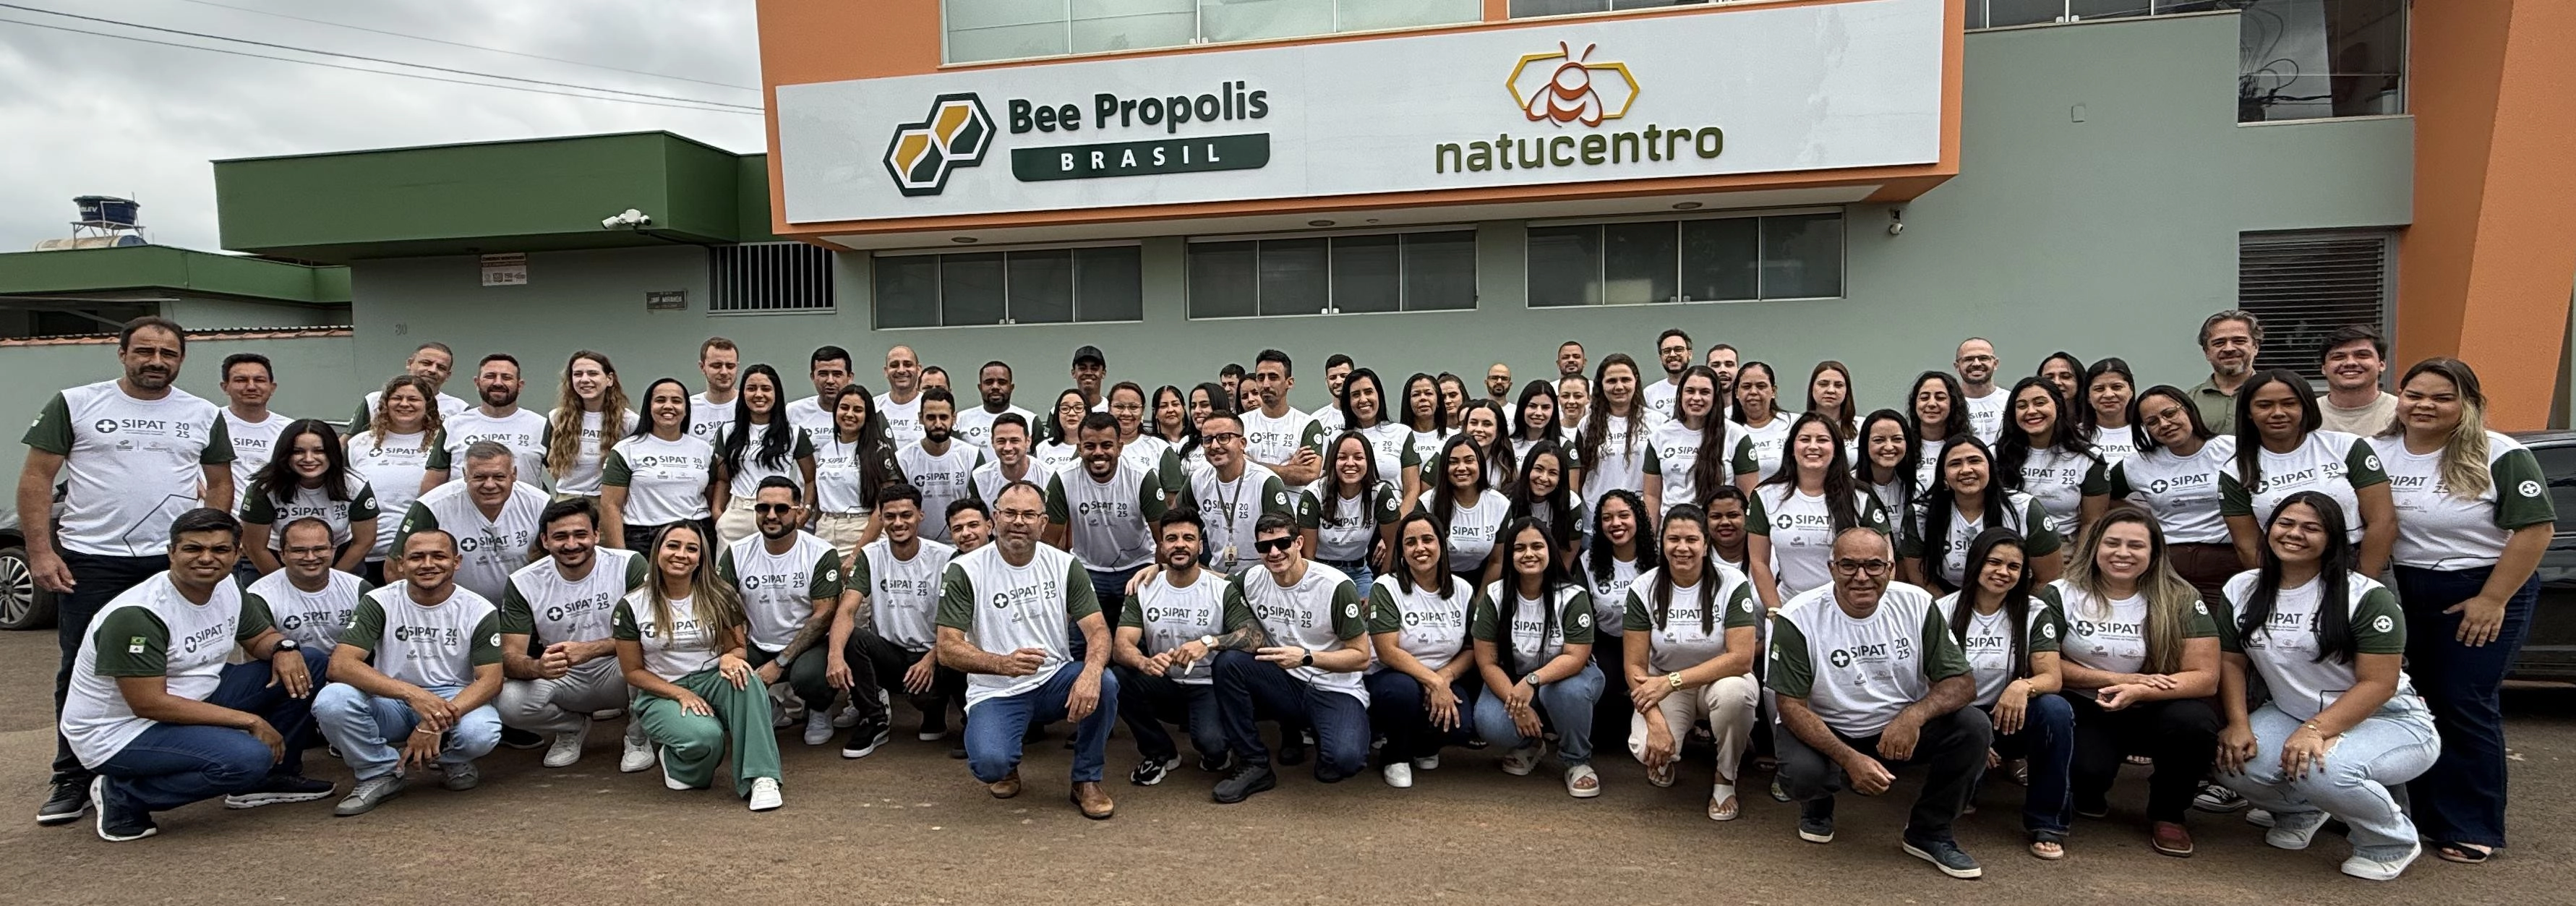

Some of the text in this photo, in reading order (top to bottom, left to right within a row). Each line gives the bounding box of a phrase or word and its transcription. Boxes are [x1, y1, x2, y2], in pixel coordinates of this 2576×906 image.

[1008, 80, 1269, 134] Bee Propolis
[1436, 124, 1723, 174] natucentro
[1060, 144, 1220, 171] BRASIL
[121, 419, 166, 430] SIPAT
[175, 422, 189, 430] 20
[234, 437, 268, 448] SIPAT
[1677, 446, 1699, 455] SIPA
[659, 455, 688, 464] SIPAT
[2020, 467, 2055, 477] SIPAT
[2321, 462, 2339, 471] 20
[925, 472, 950, 481] SIPAT
[2171, 473, 2209, 486] SIPAT
[2272, 468, 2314, 486] SIPAT
[2388, 474, 2428, 486] SIPAT
[291, 507, 328, 517] SIPAT
[1795, 514, 1830, 525] SIPAT
[515, 530, 527, 539] 20
[1452, 526, 1480, 537] SIPAT
[517, 539, 528, 547] 25
[761, 573, 787, 584] SIPAT
[889, 579, 912, 589] SIPAT
[1043, 581, 1055, 589] 20
[595, 592, 609, 602] 20
[1009, 584, 1037, 599] SIPAT
[1045, 590, 1056, 599] 25
[564, 598, 593, 613] SIPAT
[596, 602, 610, 611] 25
[338, 610, 352, 618] 20
[1162, 607, 1191, 617] SIPAT
[1270, 605, 1296, 619] SIPAT
[1301, 610, 1312, 619] 20
[1420, 611, 1446, 622] SIPAT
[1669, 609, 1703, 619] SIPAT
[2269, 612, 2303, 625] IPAT
[672, 619, 699, 631] IPAT
[1514, 620, 1544, 632] SIPAT
[2098, 622, 2141, 634] SIPAT
[195, 623, 223, 644] SIPAT
[408, 627, 440, 638] SIPAT
[445, 637, 457, 646] 25
[1894, 637, 1909, 649] 20
[1966, 637, 2004, 648] SIPAT
[1850, 643, 1886, 658] SIPAT
[1897, 648, 1910, 659] 25
